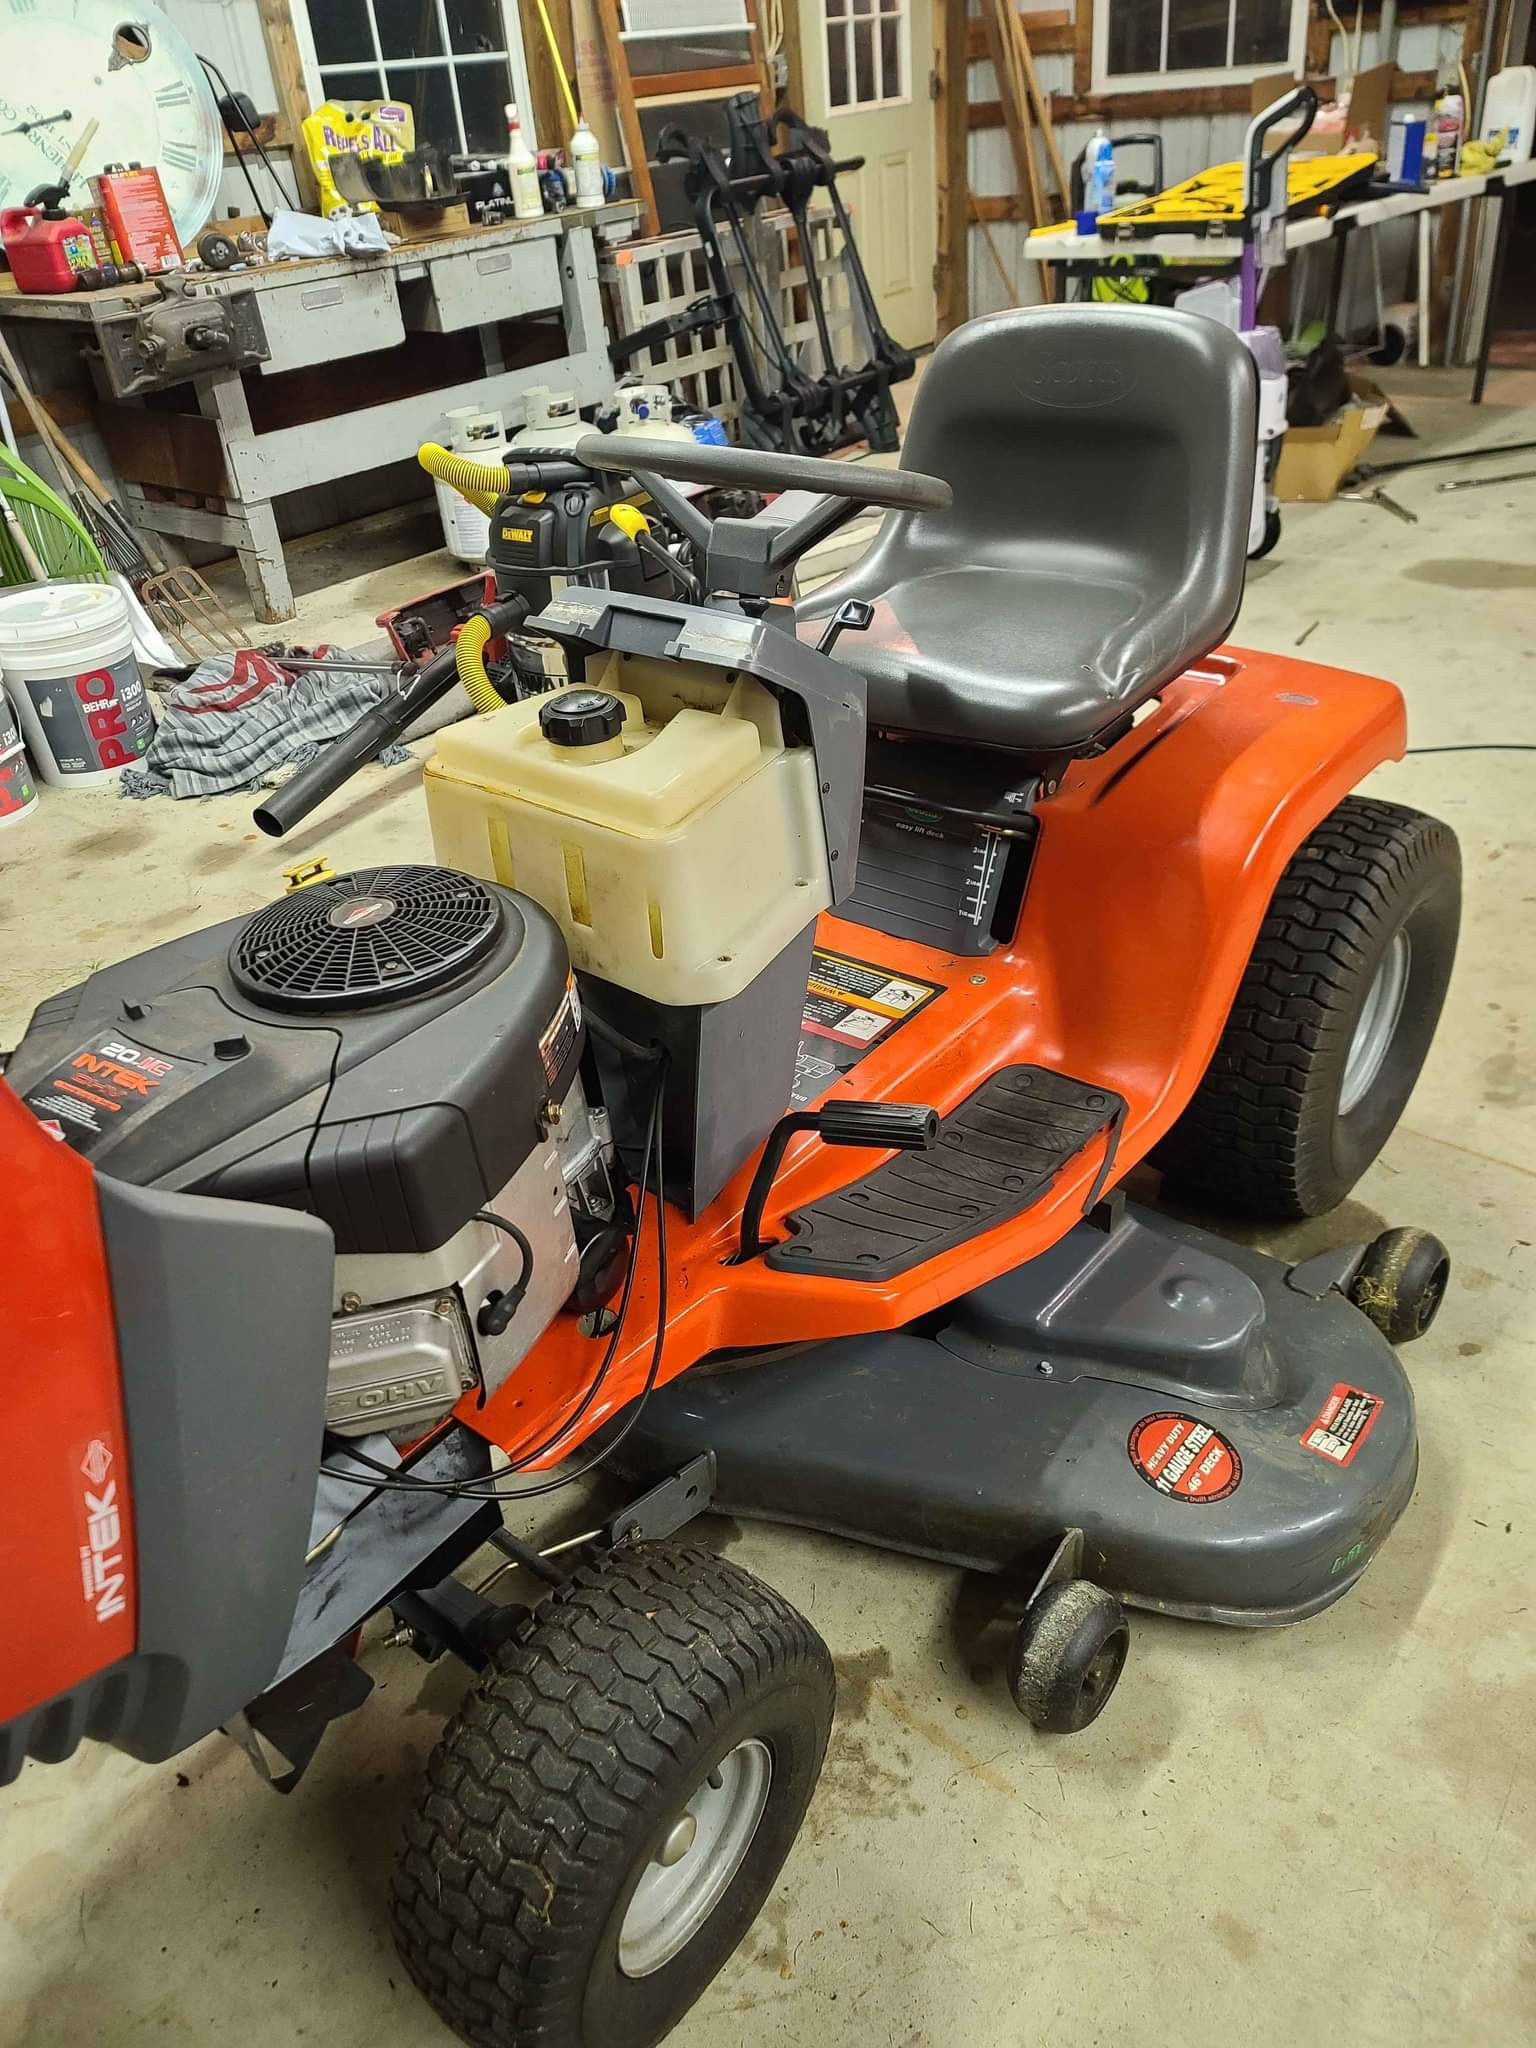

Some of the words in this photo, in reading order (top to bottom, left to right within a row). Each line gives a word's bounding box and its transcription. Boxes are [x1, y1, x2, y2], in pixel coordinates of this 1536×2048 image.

[82, 698, 110, 713] BEHR
[120, 680, 142, 702] i300
[75, 668, 137, 769] PRO
[895, 821, 913, 832] easy
[914, 824, 925, 834] lift
[926, 828, 945, 839] deck
[71, 1052, 161, 1096] INTEK
[357, 1376, 444, 1408] OHV
[1146, 1442, 1169, 1471] HEAVY
[1166, 1421, 1185, 1446] DUTY
[1184, 1423, 1215, 1454] STEEL
[1162, 1445, 1196, 1483] GAUGE
[1199, 1446, 1225, 1476] DECK
[1155, 1476, 1173, 1493] 11
[84, 1479, 126, 1623] INTEK
